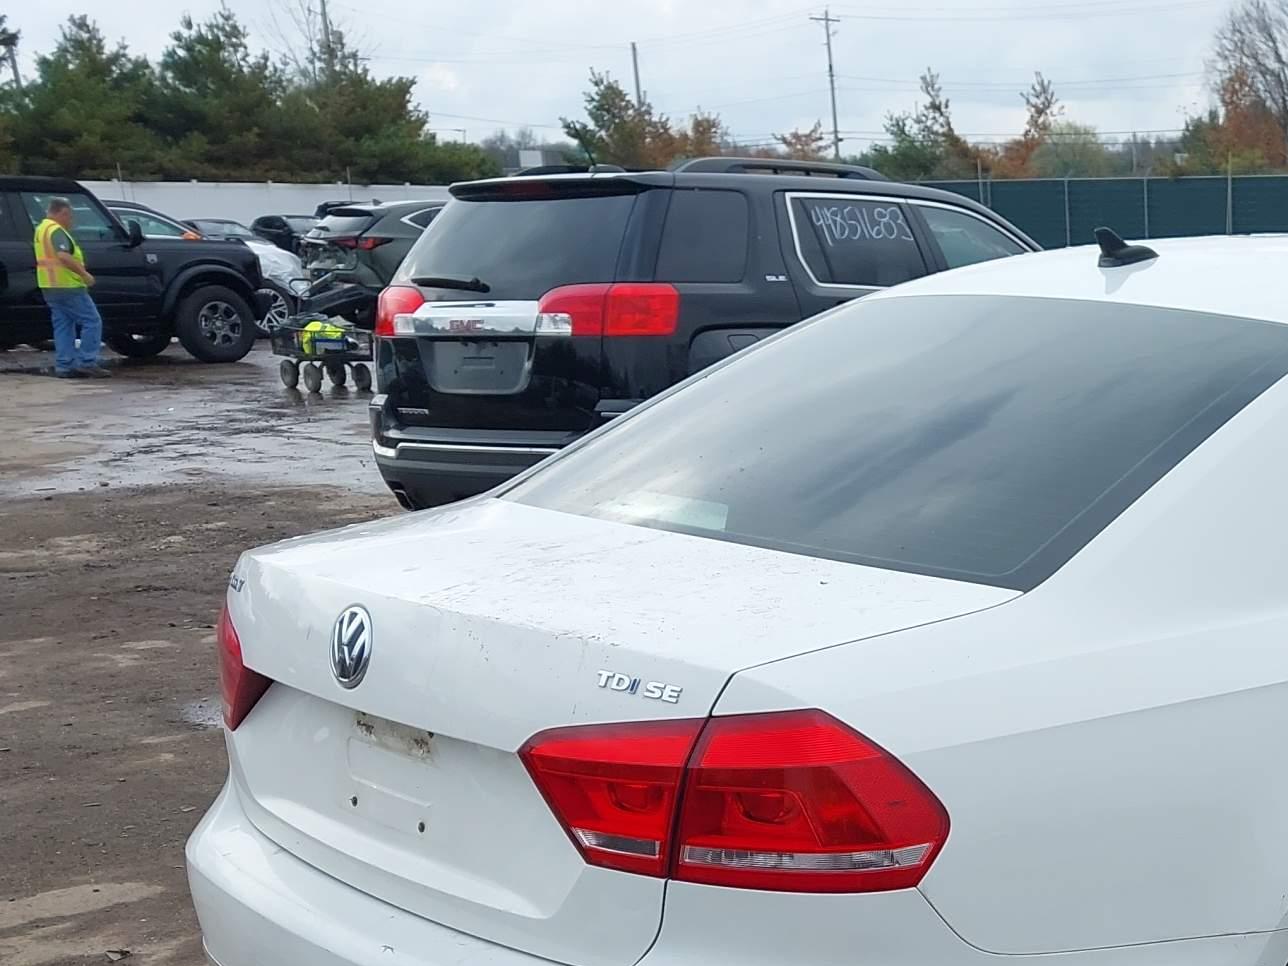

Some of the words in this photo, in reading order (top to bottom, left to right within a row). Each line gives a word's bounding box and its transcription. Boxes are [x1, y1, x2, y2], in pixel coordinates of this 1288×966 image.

[810, 205, 914, 246] 44851683
[449, 319, 485, 331] GMC
[597, 669, 641, 694] TDI
[643, 681, 683, 704] SE
